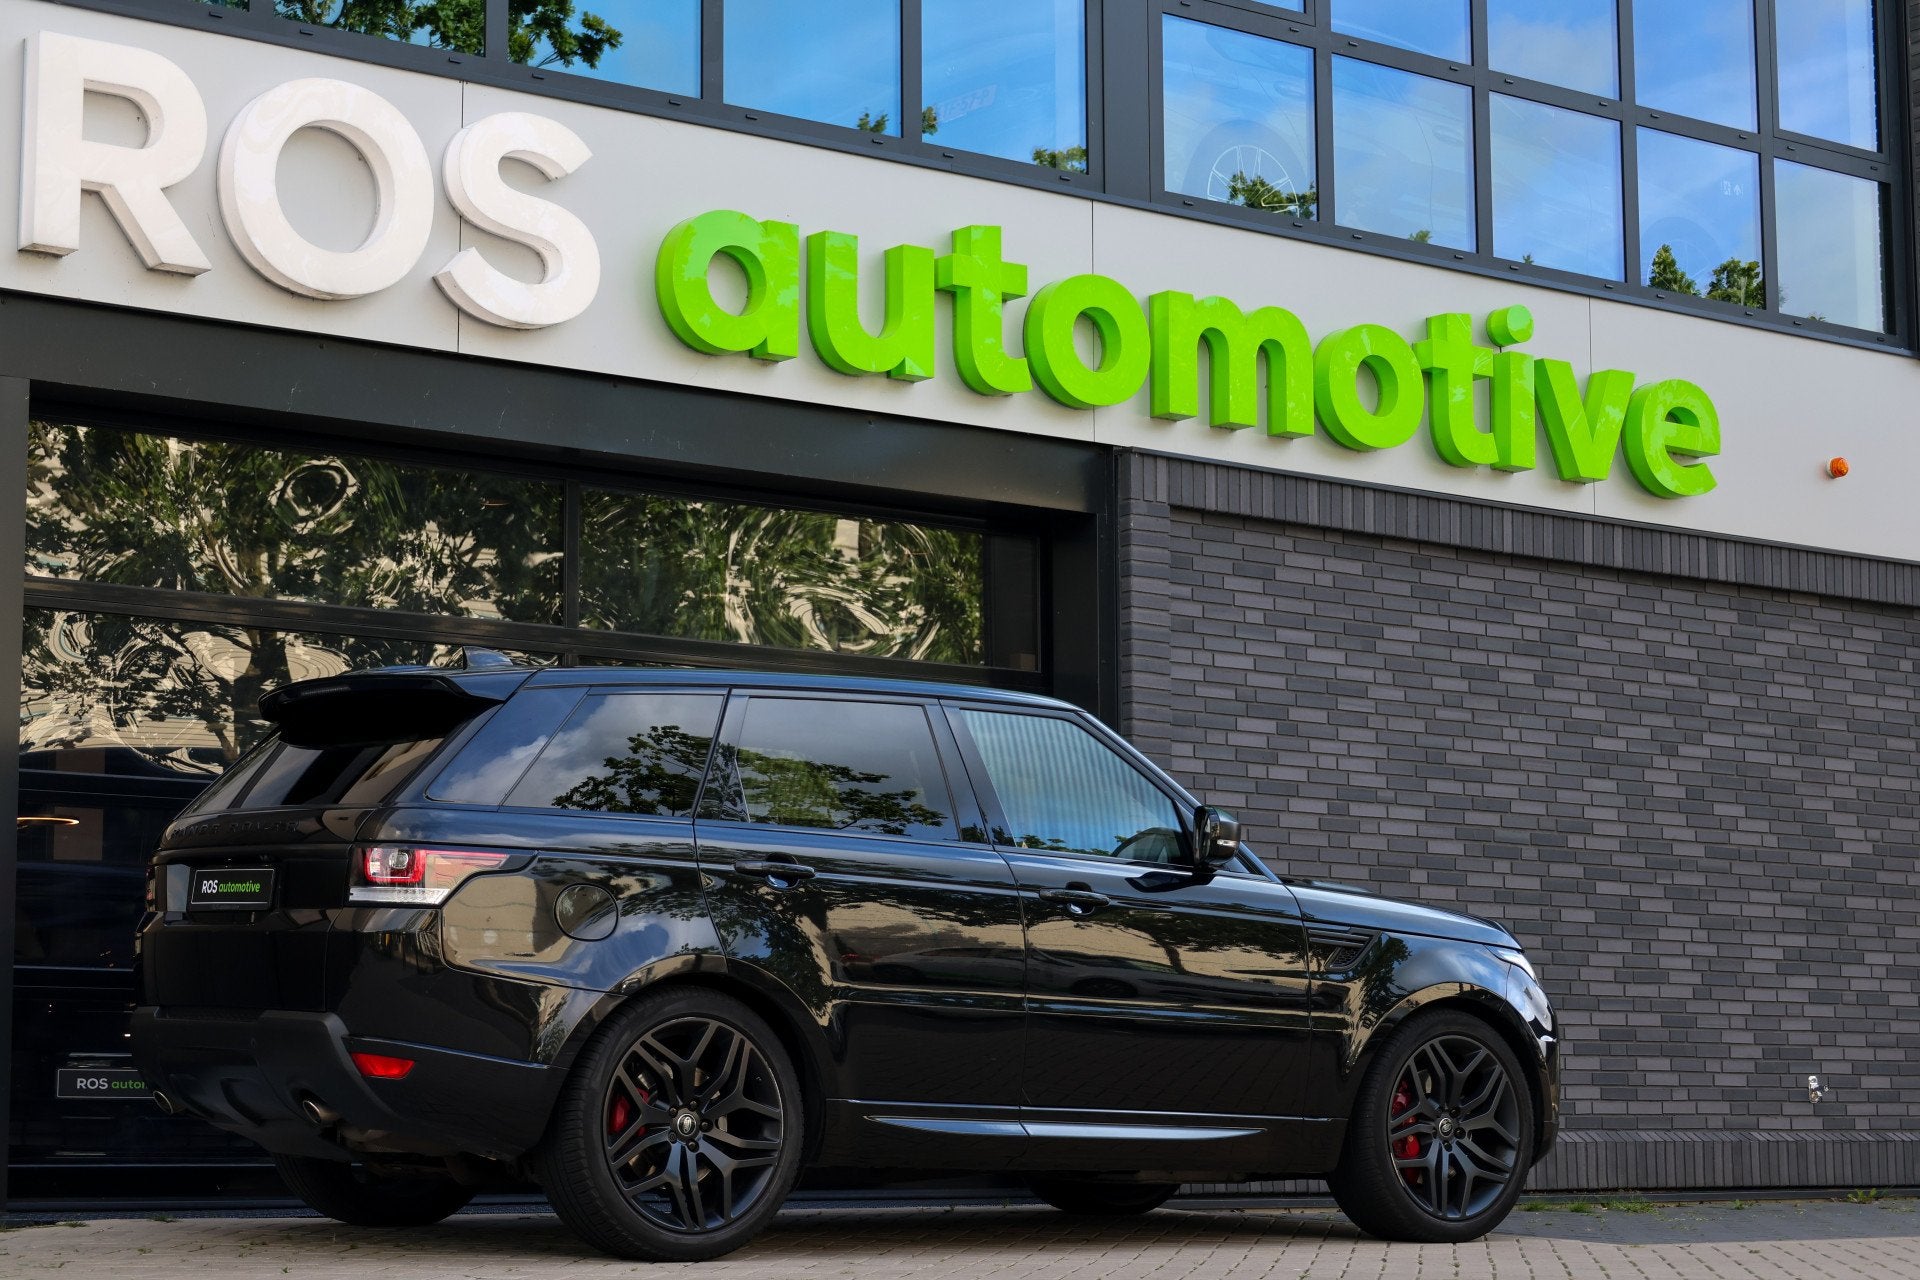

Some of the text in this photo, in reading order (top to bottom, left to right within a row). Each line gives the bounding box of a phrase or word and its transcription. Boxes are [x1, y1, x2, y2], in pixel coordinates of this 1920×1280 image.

[18, 30, 1721, 499] ROS automotive
[201, 879, 261, 894] ROS automotive
[76, 1078, 109, 1090] ROS
